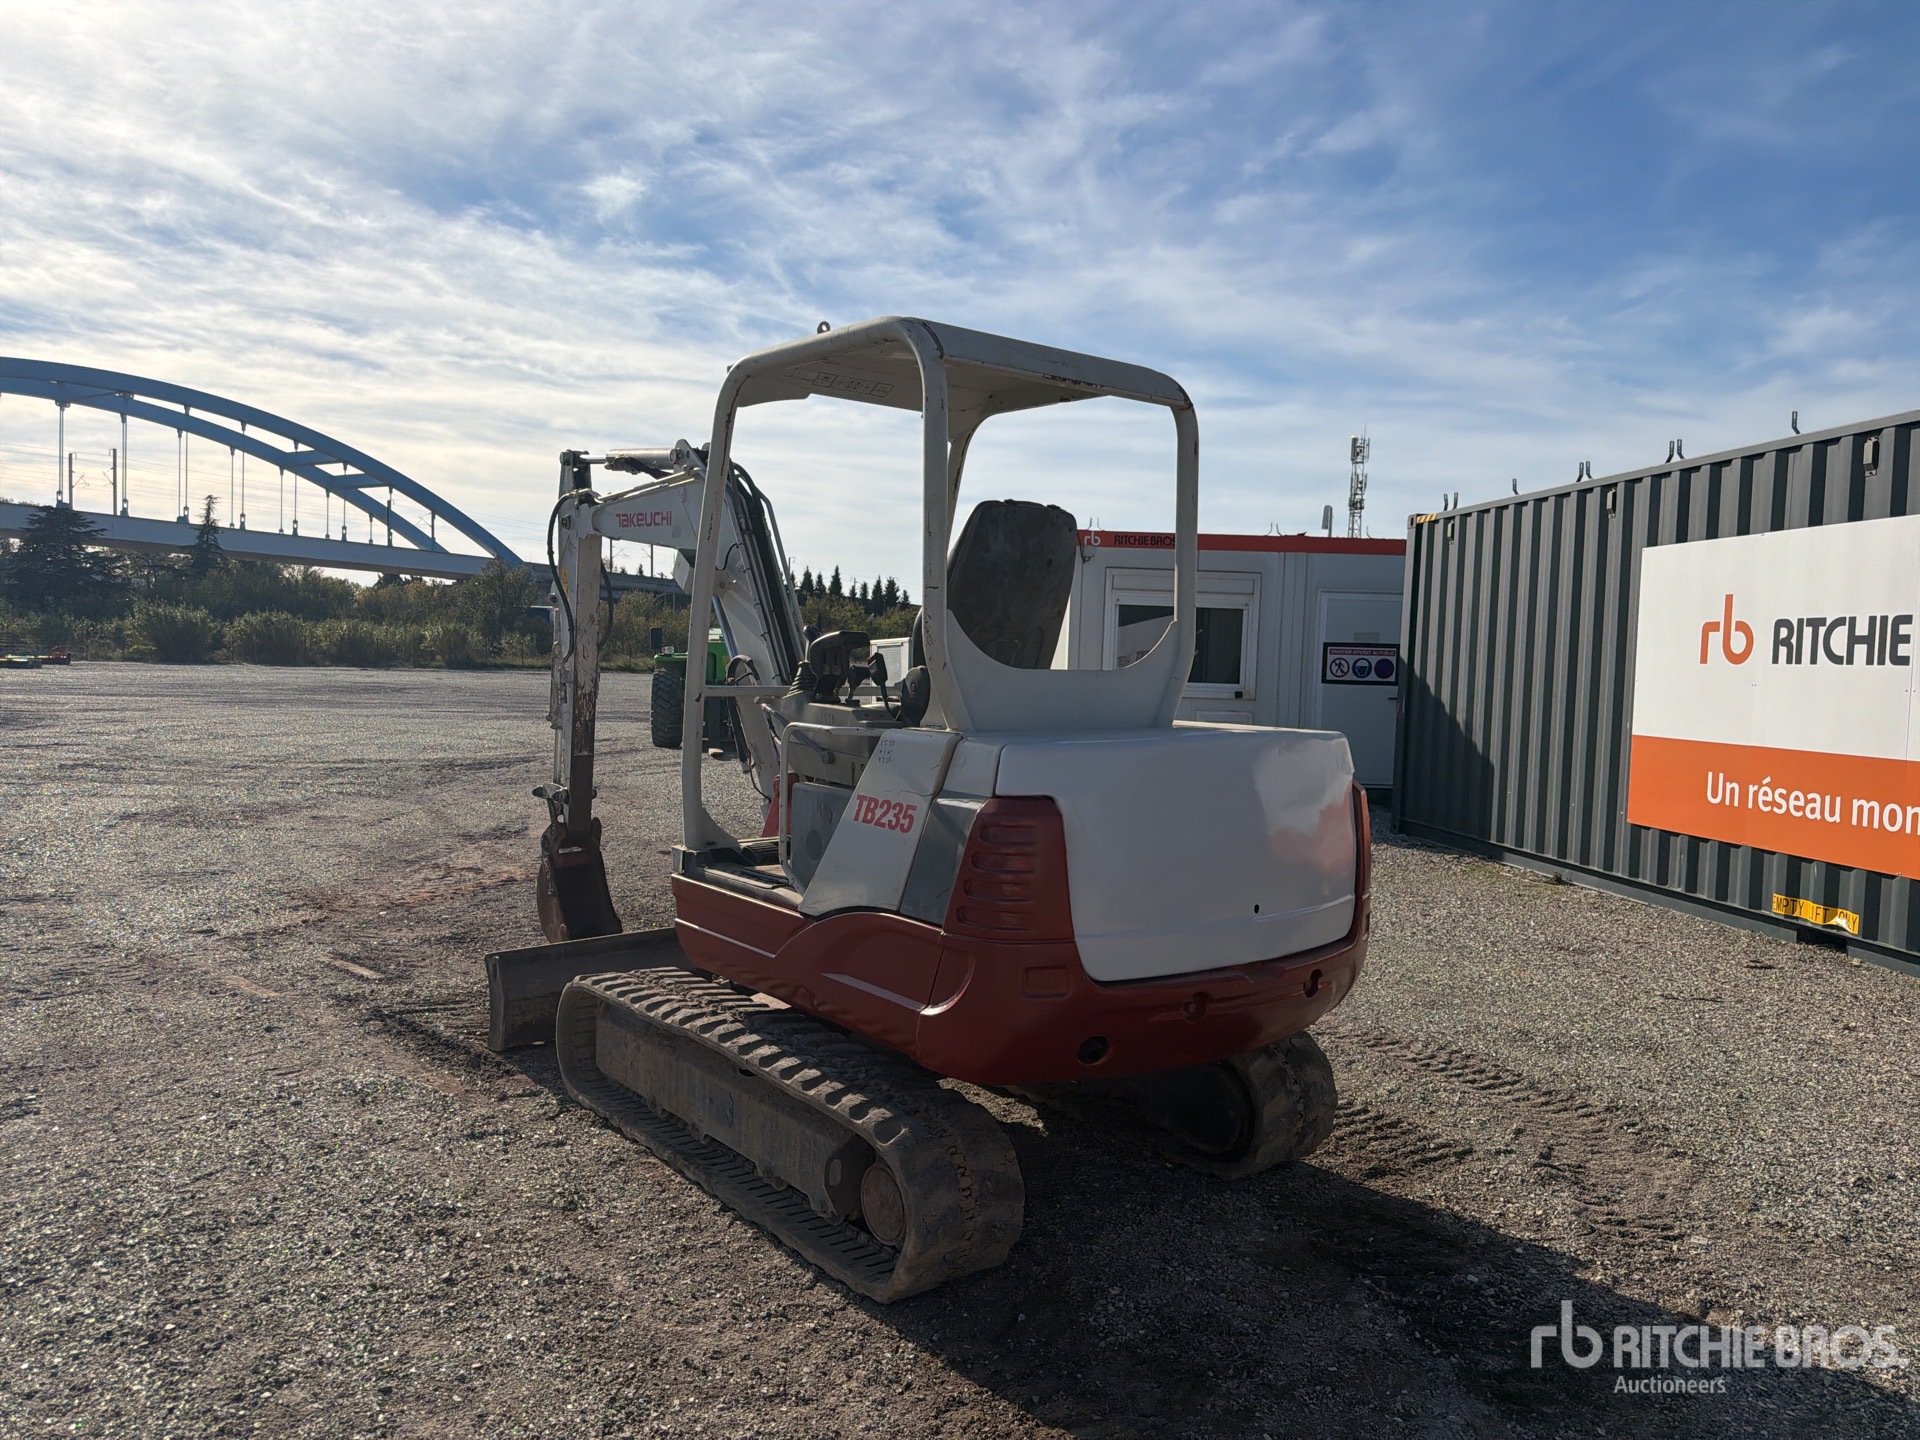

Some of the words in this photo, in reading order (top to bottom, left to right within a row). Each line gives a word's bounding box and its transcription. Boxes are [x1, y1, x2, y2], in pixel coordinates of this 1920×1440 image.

[1114, 535, 1149, 546] RITCHIE
[1700, 594, 1754, 665] rb
[1771, 614, 1913, 666] RITCHIE
[853, 794, 917, 833] TB235
[1707, 771, 1739, 807] Un
[1748, 776, 1841, 823] réseau
[1851, 798, 1920, 836] mon
